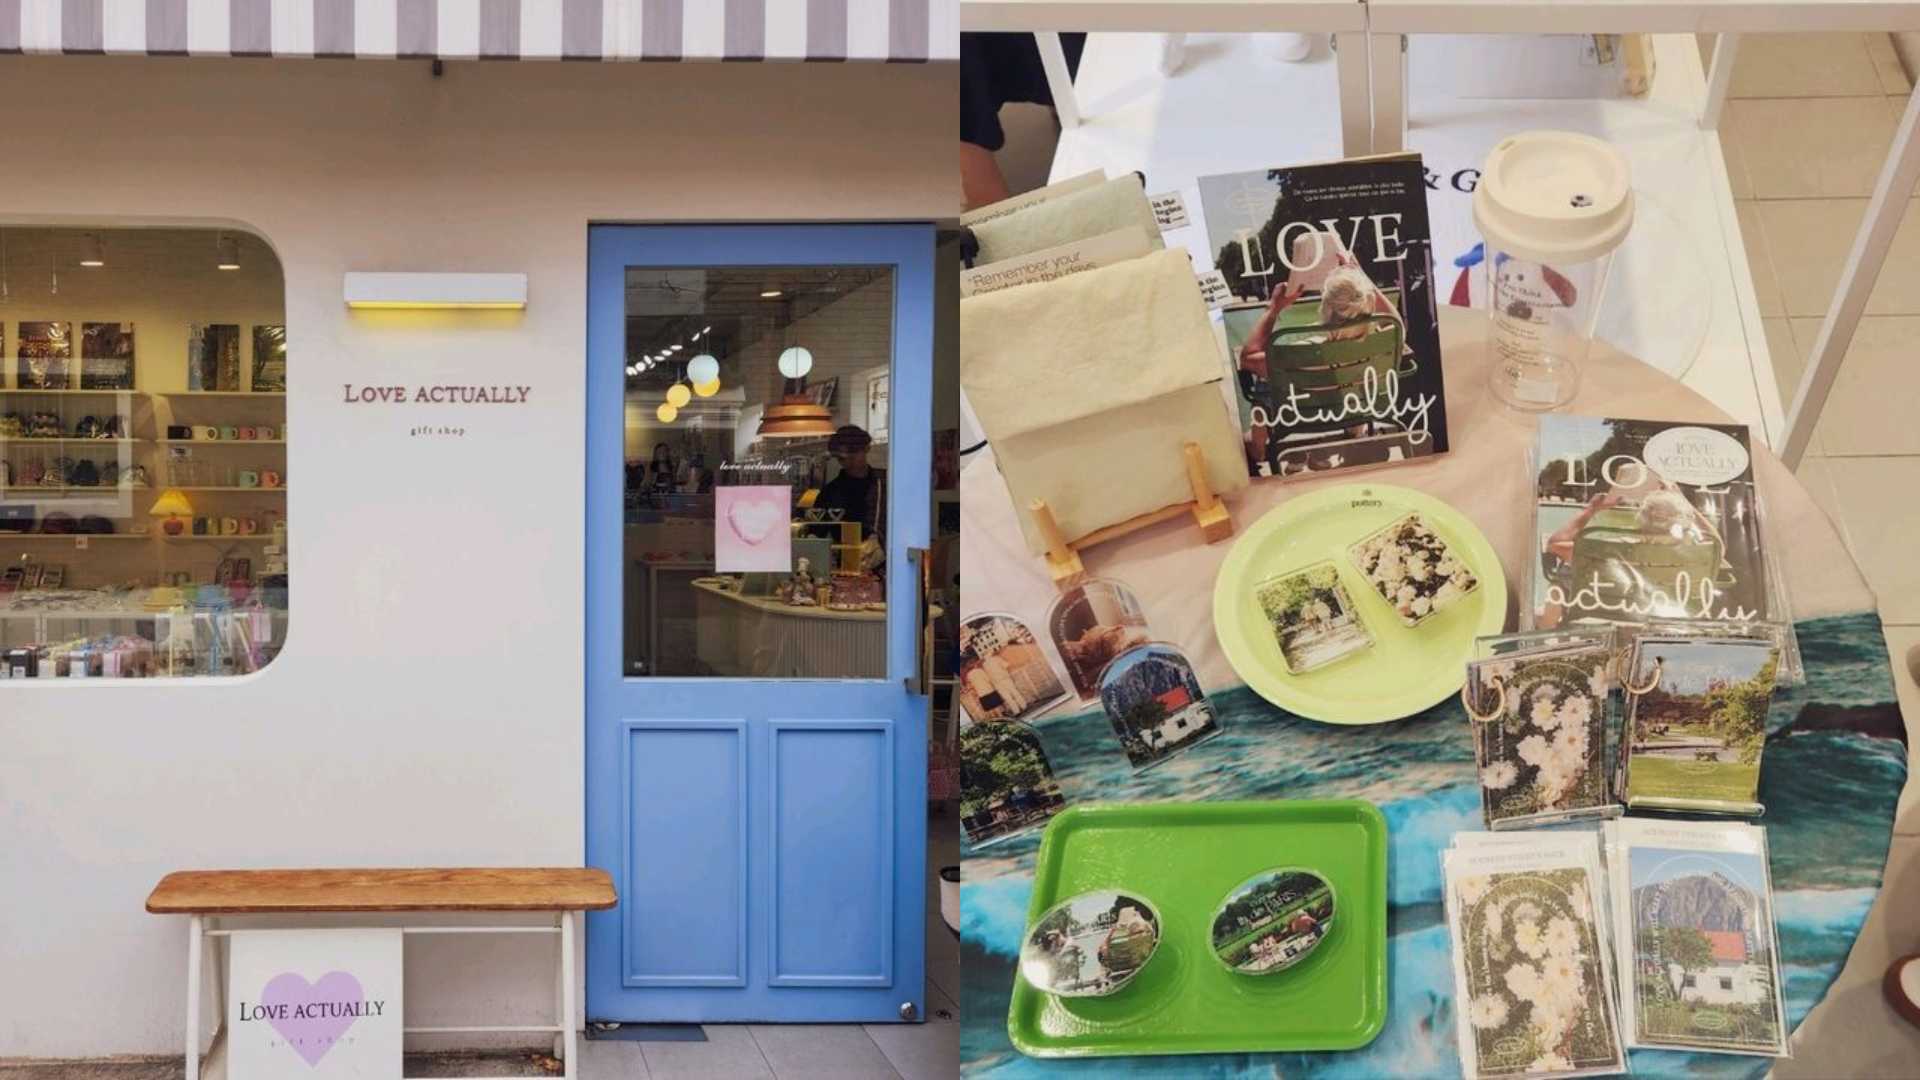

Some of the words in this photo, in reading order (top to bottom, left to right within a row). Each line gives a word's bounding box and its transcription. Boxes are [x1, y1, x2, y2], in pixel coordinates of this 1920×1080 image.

[1236, 212, 1408, 279] LOVE
[1050, 251, 1081, 267] your
[344, 384, 407, 403] LOVE
[415, 386, 531, 403] ACTUALLY
[1250, 366, 1437, 445] actually
[410, 426, 433, 436] gift
[437, 426, 465, 436] shop
[719, 461, 741, 471] love
[743, 460, 792, 475] actually
[239, 1002, 289, 1022] LOVE
[294, 1001, 385, 1020] ACTUALLY
